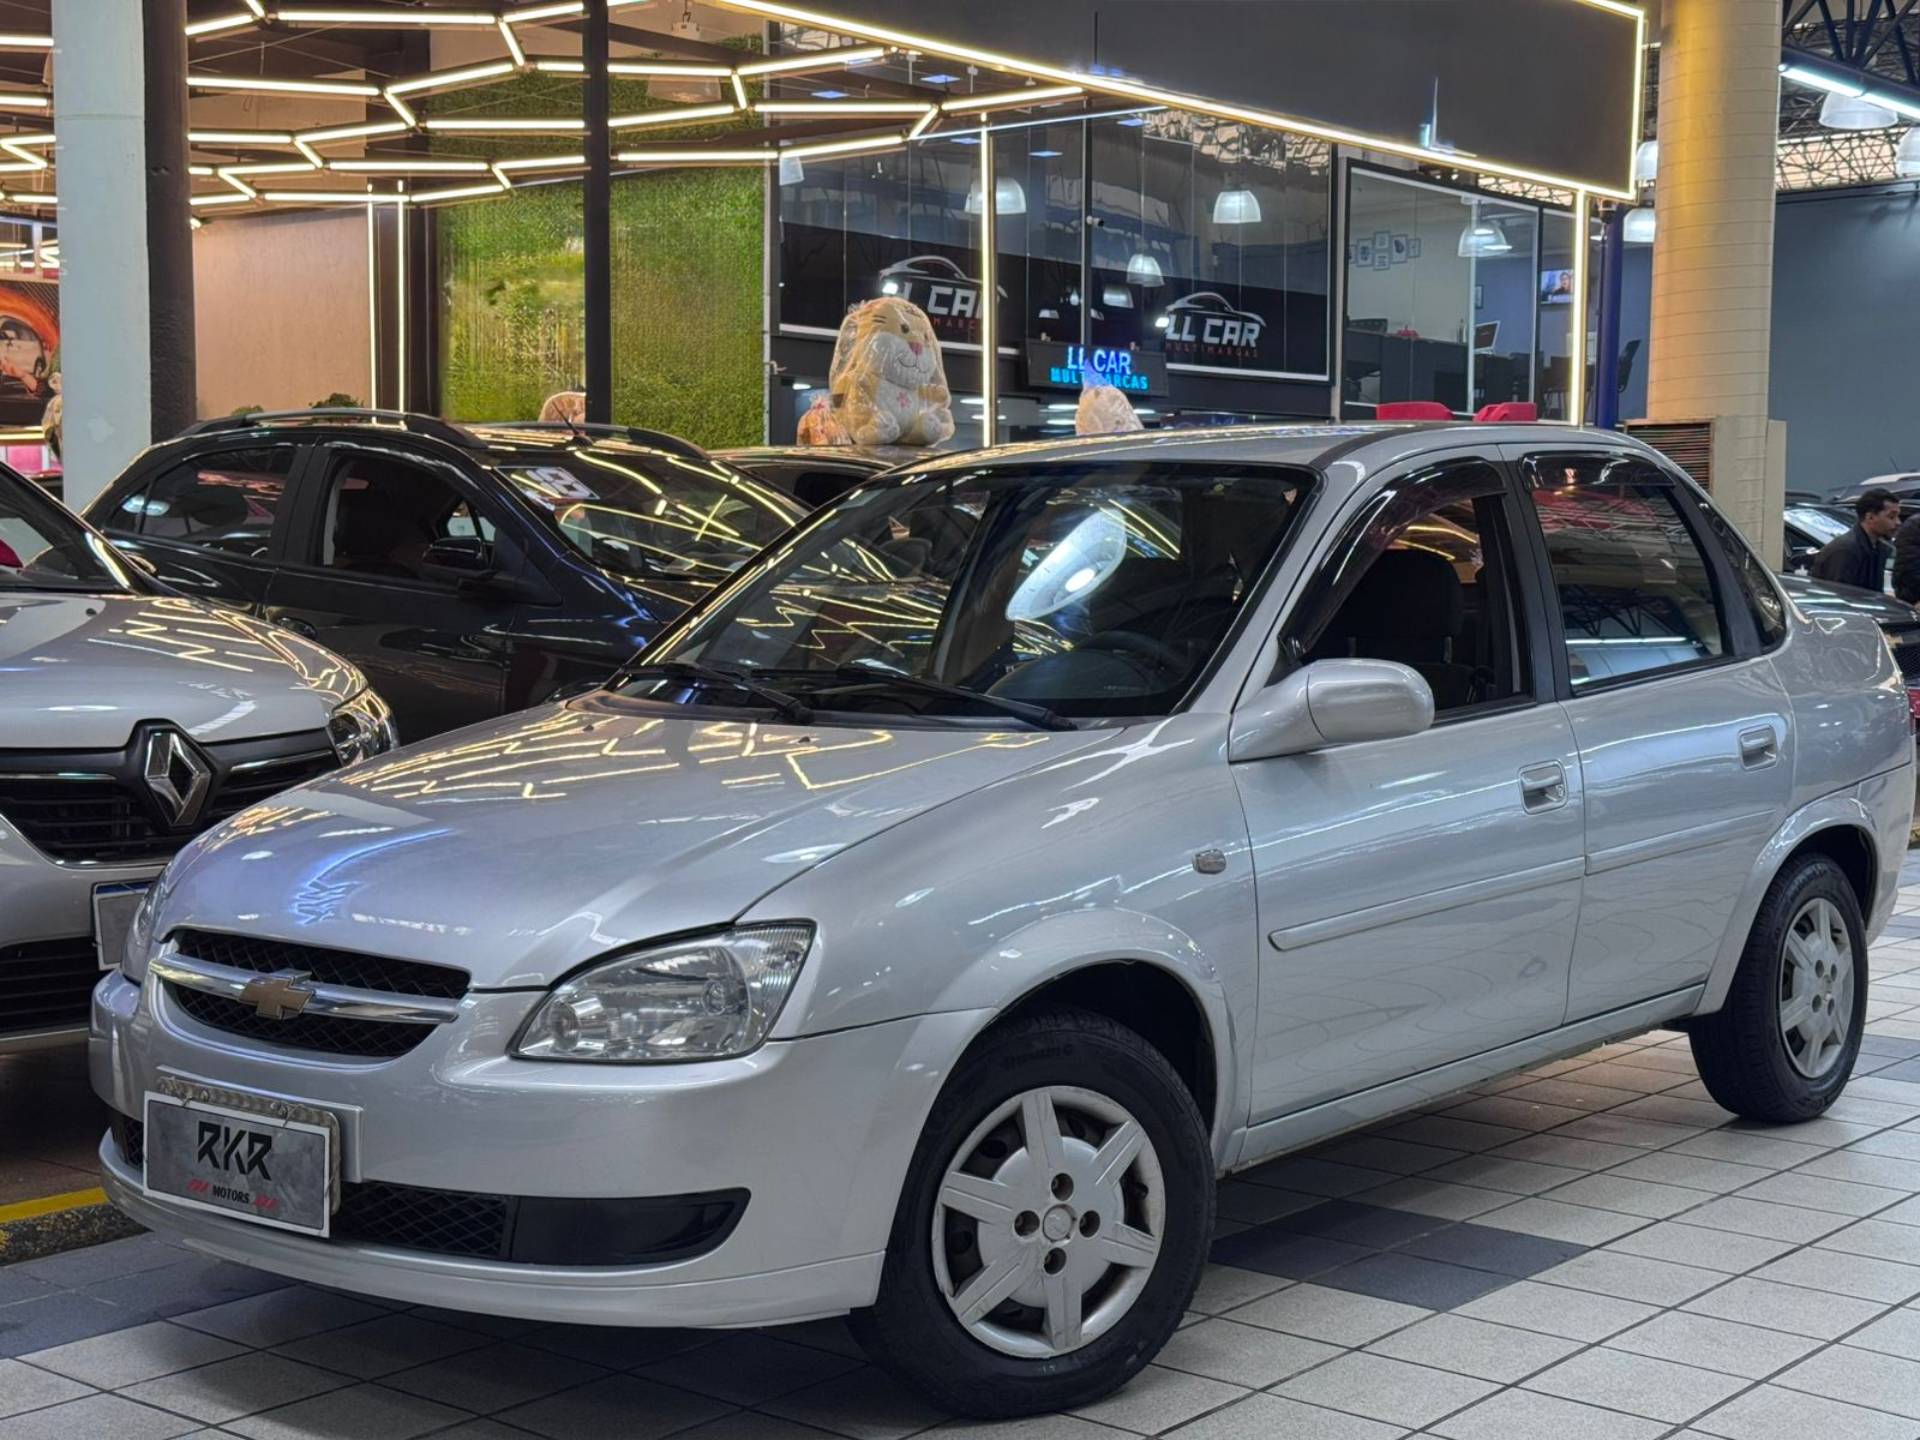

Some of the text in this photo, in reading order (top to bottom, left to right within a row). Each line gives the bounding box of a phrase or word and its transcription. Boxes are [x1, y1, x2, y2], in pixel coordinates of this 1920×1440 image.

[1165, 313, 1261, 348] LL CAR
[1066, 345, 1132, 375] LL CAR
[198, 1120, 272, 1181] RKR
[212, 1184, 250, 1204] MOTORS
